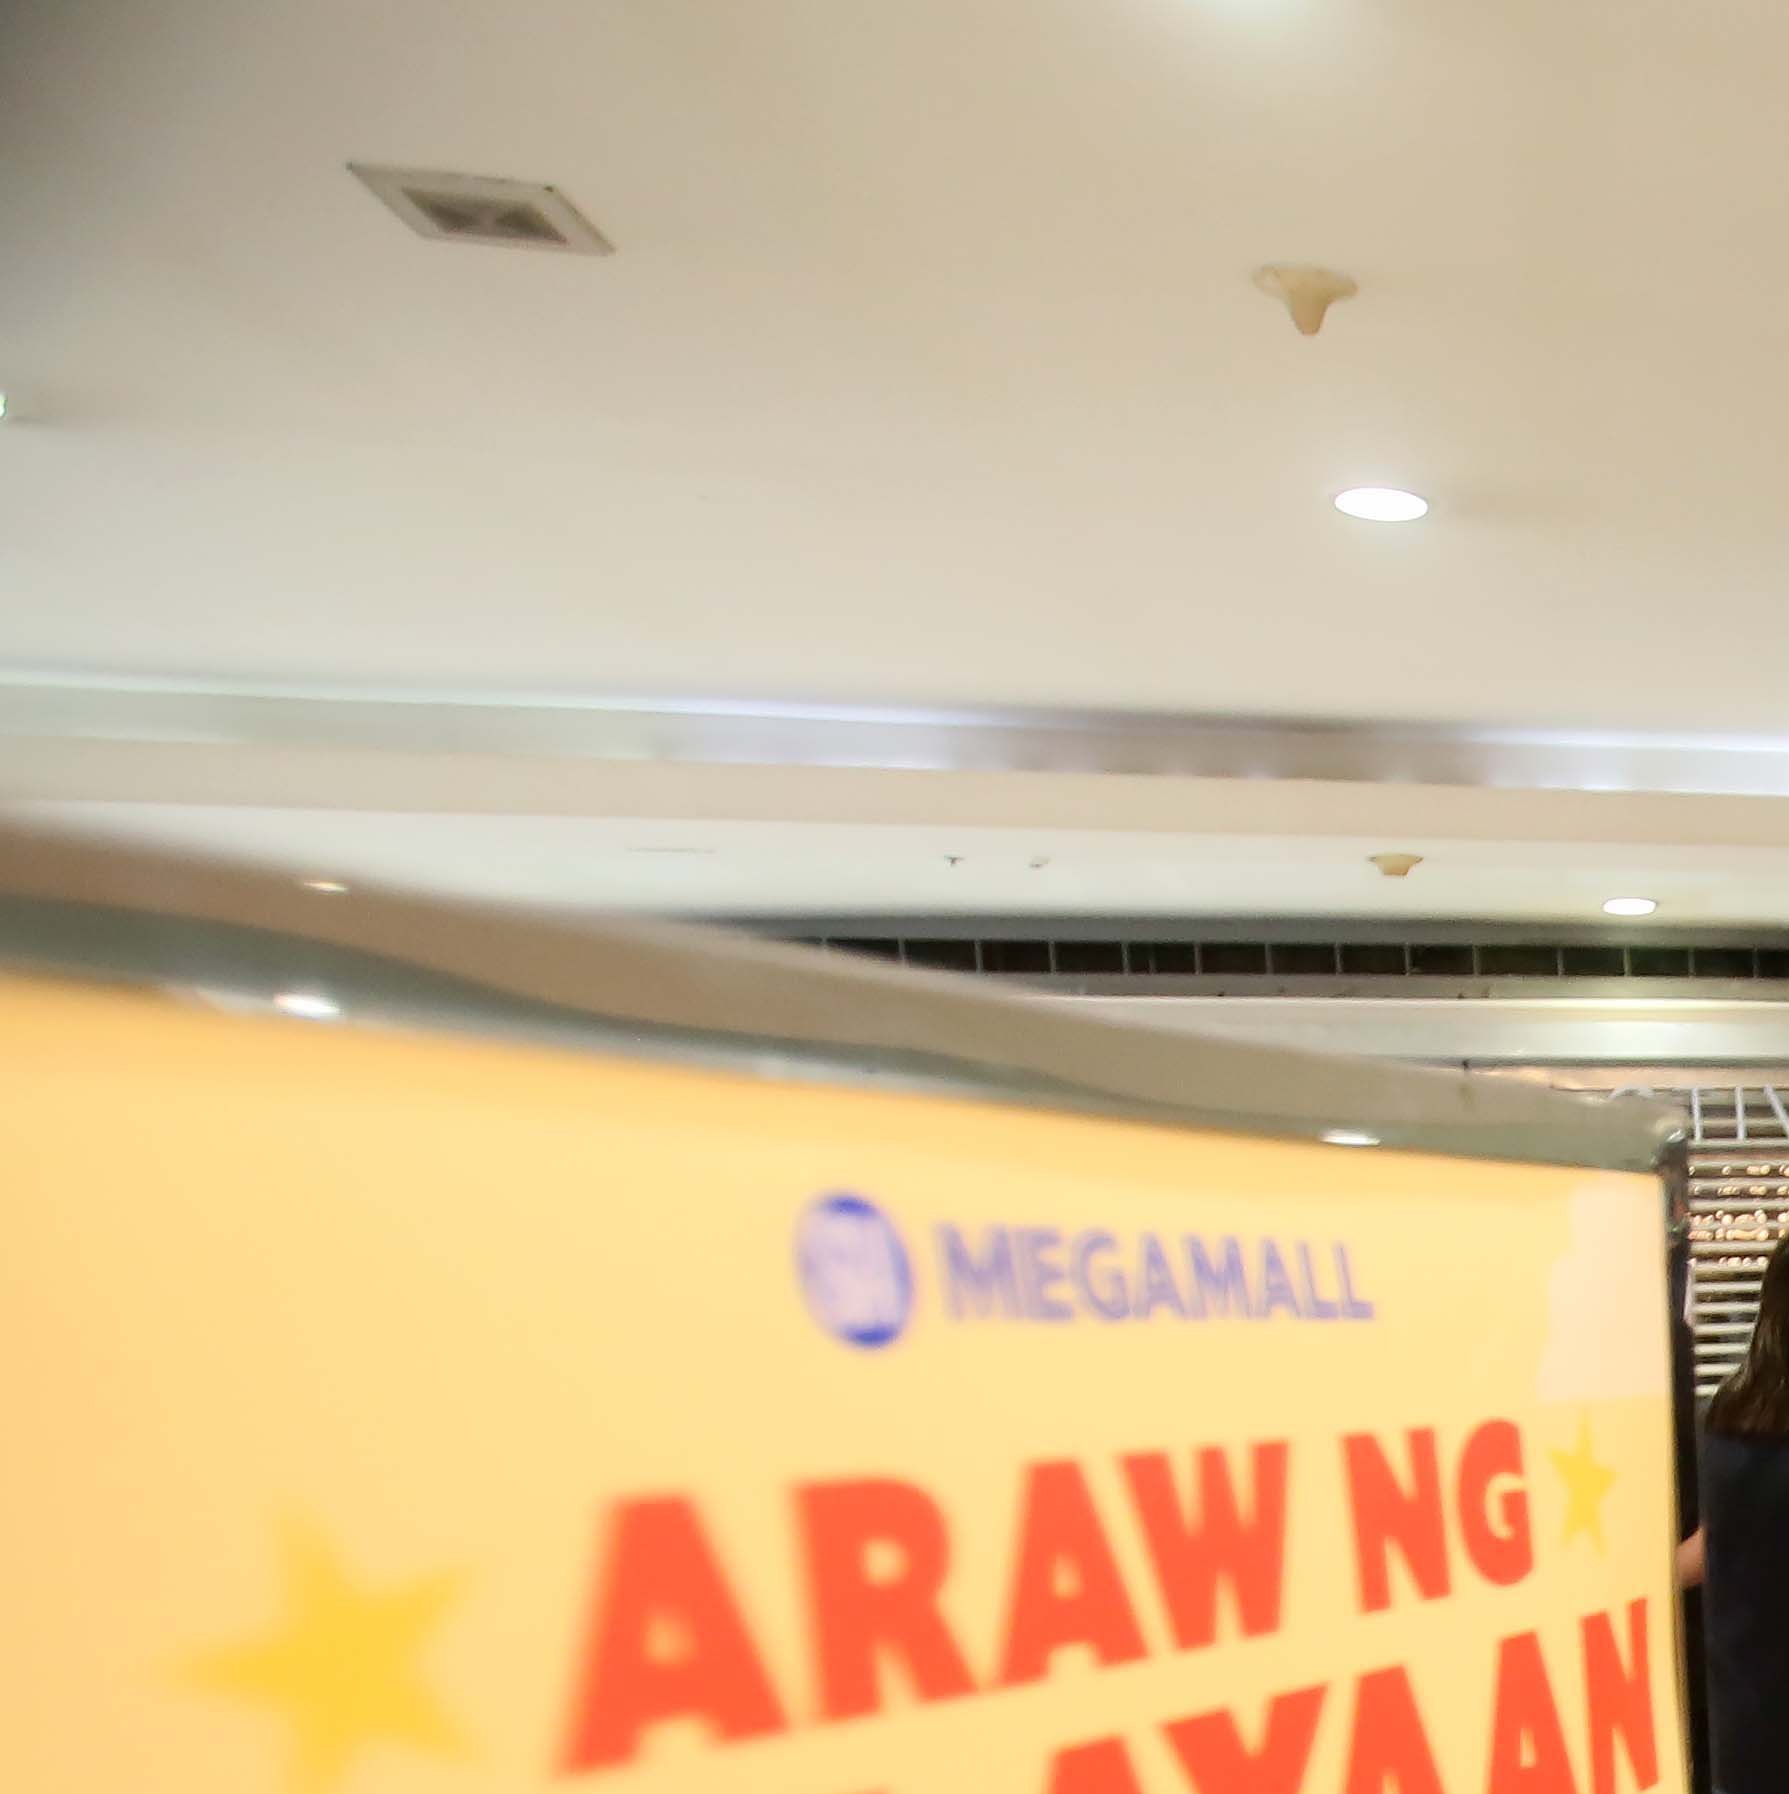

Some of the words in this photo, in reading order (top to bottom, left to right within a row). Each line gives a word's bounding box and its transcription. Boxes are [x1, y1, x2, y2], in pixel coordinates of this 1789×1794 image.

[938, 1222, 1374, 1320] MEGAMALL
[558, 1440, 1289, 1777] ARAW
[1340, 1417, 1534, 1615] NG
